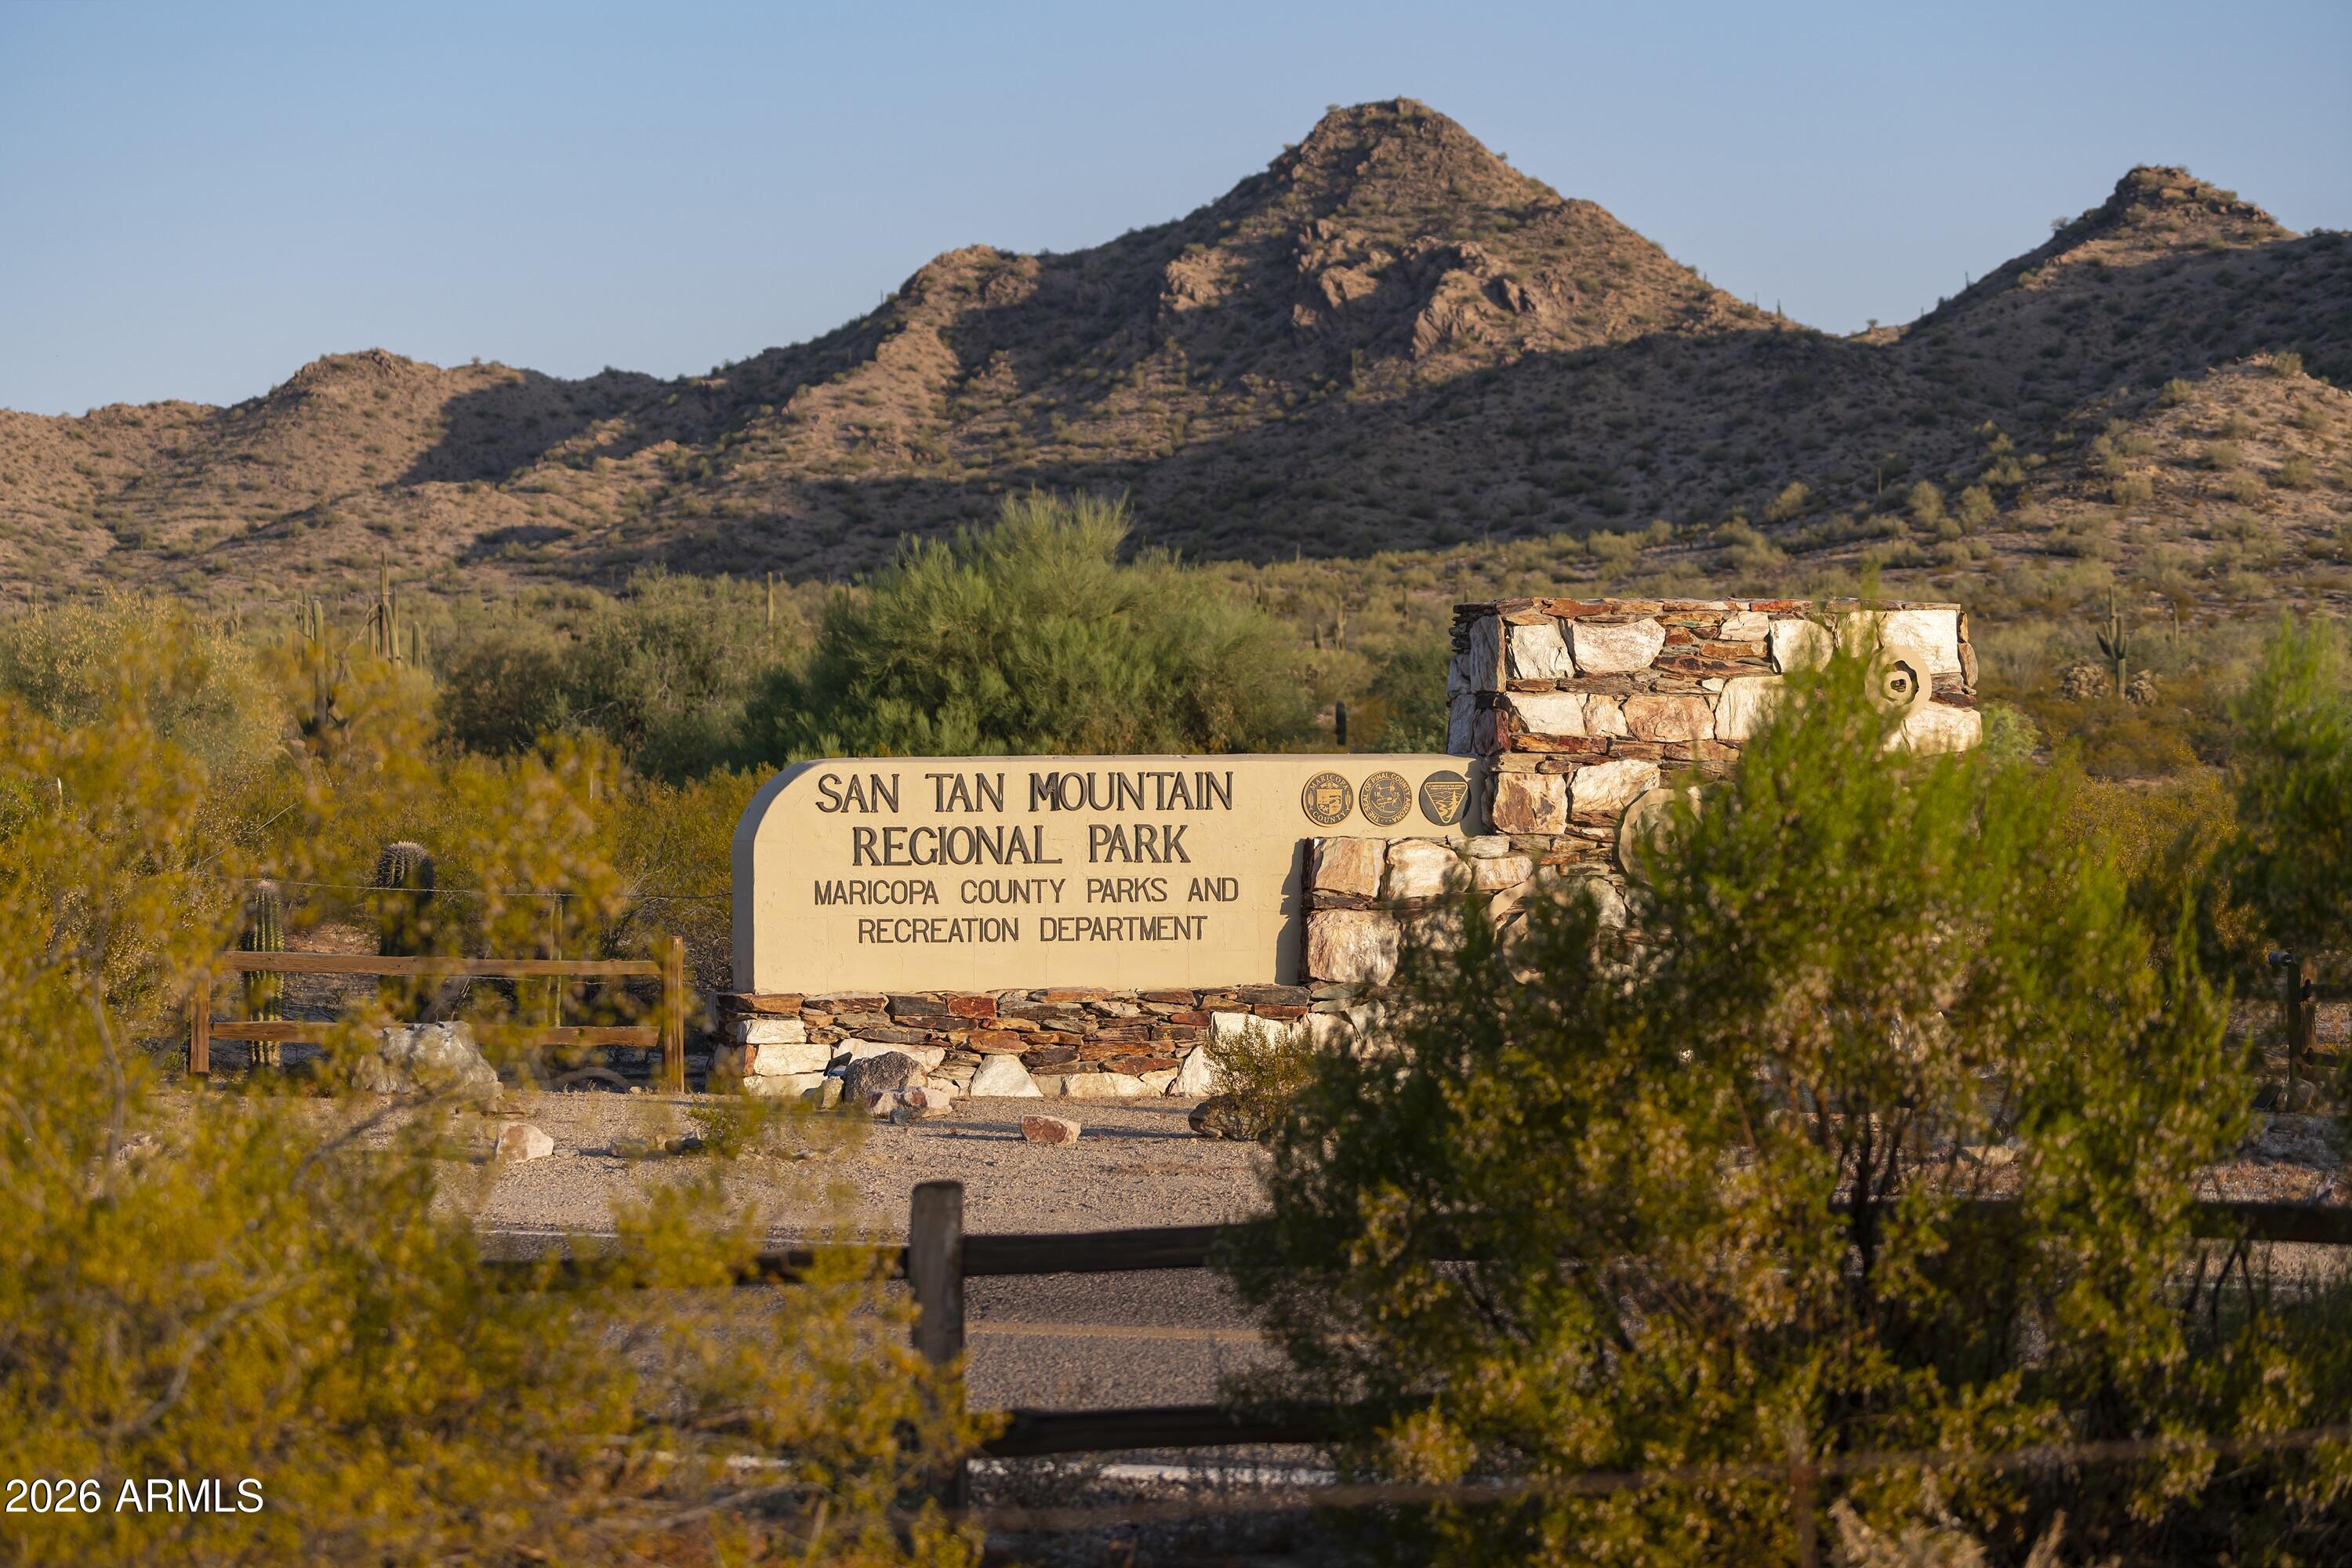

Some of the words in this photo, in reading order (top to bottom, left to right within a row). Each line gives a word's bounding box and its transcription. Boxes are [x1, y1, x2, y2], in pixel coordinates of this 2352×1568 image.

[1310, 775, 1348, 790] MARICOPA
[1364, 782, 1372, 792] OF
[1370, 772, 1390, 784] PINAL
[1391, 773, 1411, 796] COUNTY
[815, 773, 899, 813] SAN
[925, 772, 1004, 812] TAN
[1029, 771, 1233, 811] MOUNTAIN
[1312, 811, 1346, 823] COUNTY
[1368, 811, 1380, 822] THE
[1392, 797, 1411, 823] ARIZONA
[852, 826, 1062, 866] REGIONAL
[1089, 824, 1191, 863] PARK
[815, 880, 939, 905] MARICOPA
[961, 879, 1065, 904] COUNTY
[1087, 877, 1168, 903] PARKS
[1188, 877, 1239, 902] AND
[859, 918, 1018, 943] RECREATION
[1040, 916, 1207, 942] DEPARTMENT
